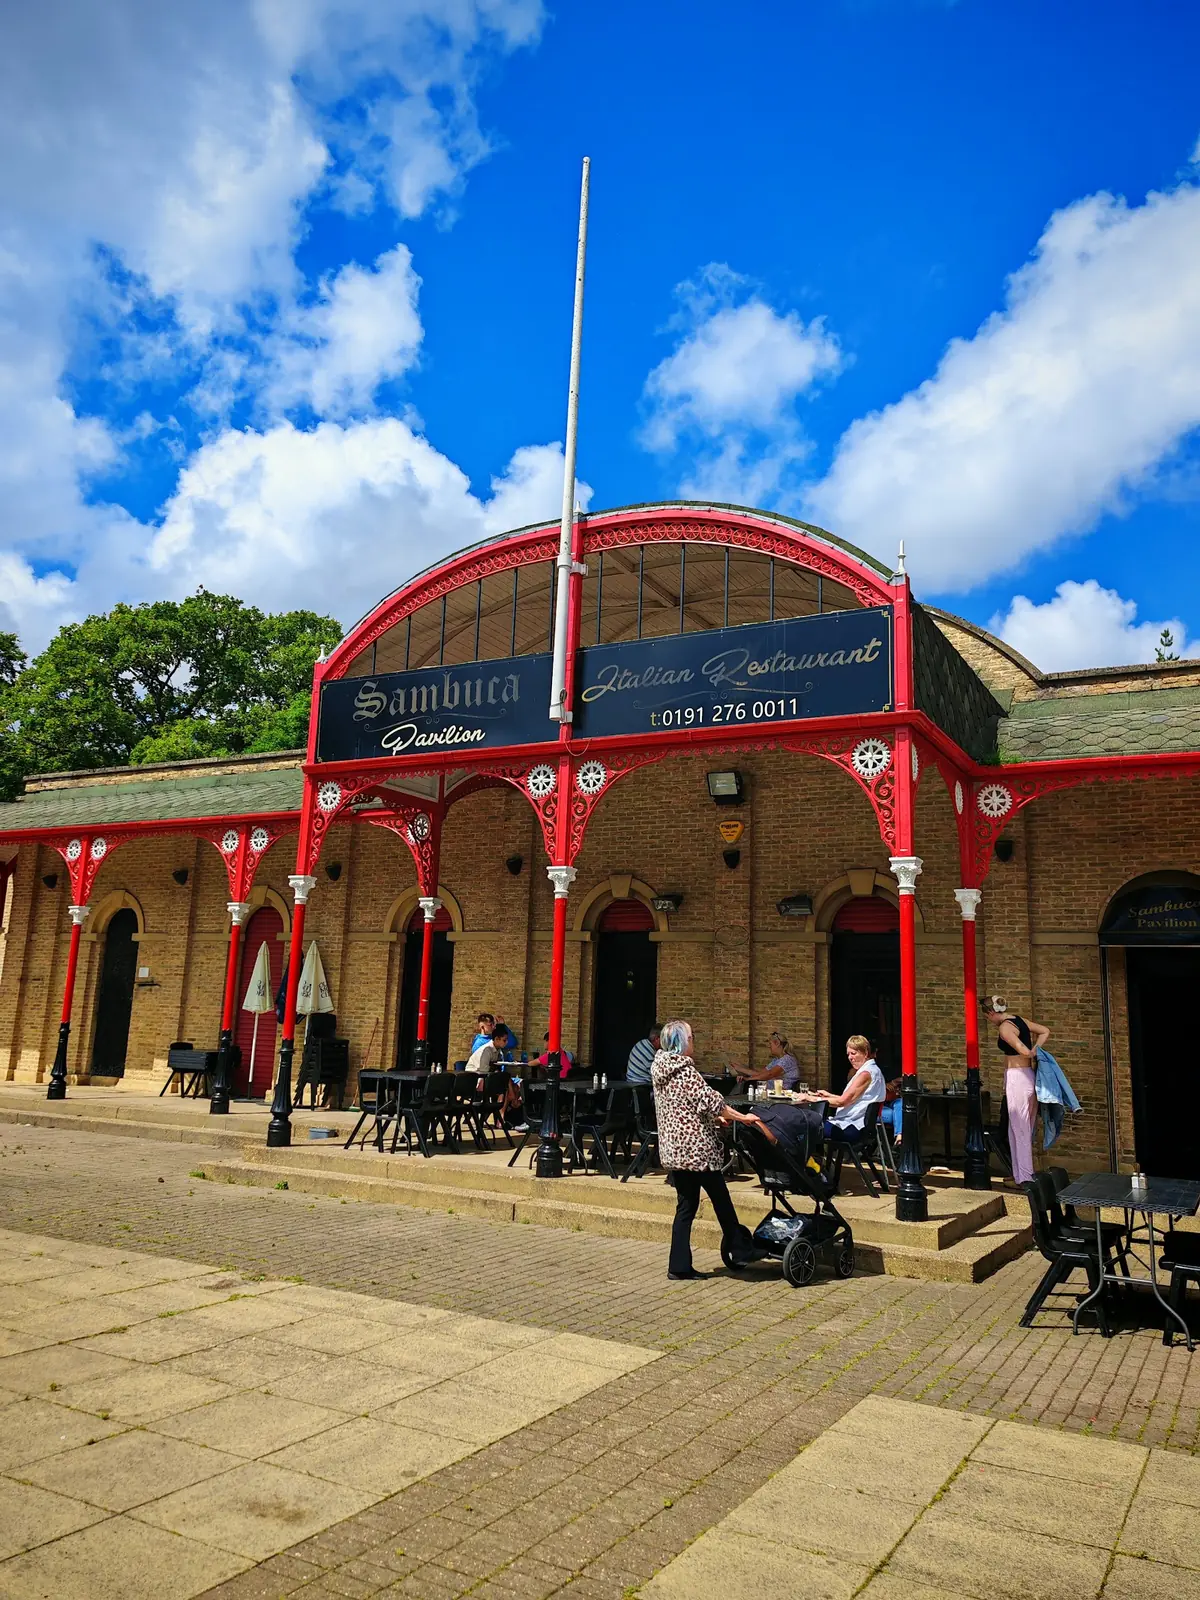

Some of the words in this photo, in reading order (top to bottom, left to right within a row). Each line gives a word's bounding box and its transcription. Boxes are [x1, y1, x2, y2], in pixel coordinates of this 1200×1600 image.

[581, 664, 695, 703] Italian
[701, 637, 882, 687] Restaurant
[352, 671, 521, 722] Sambuca
[712, 703, 746, 722] 276
[752, 698, 798, 717] 0011
[381, 723, 486, 756] Pavilion
[1138, 918, 1197, 928] Pavilion
